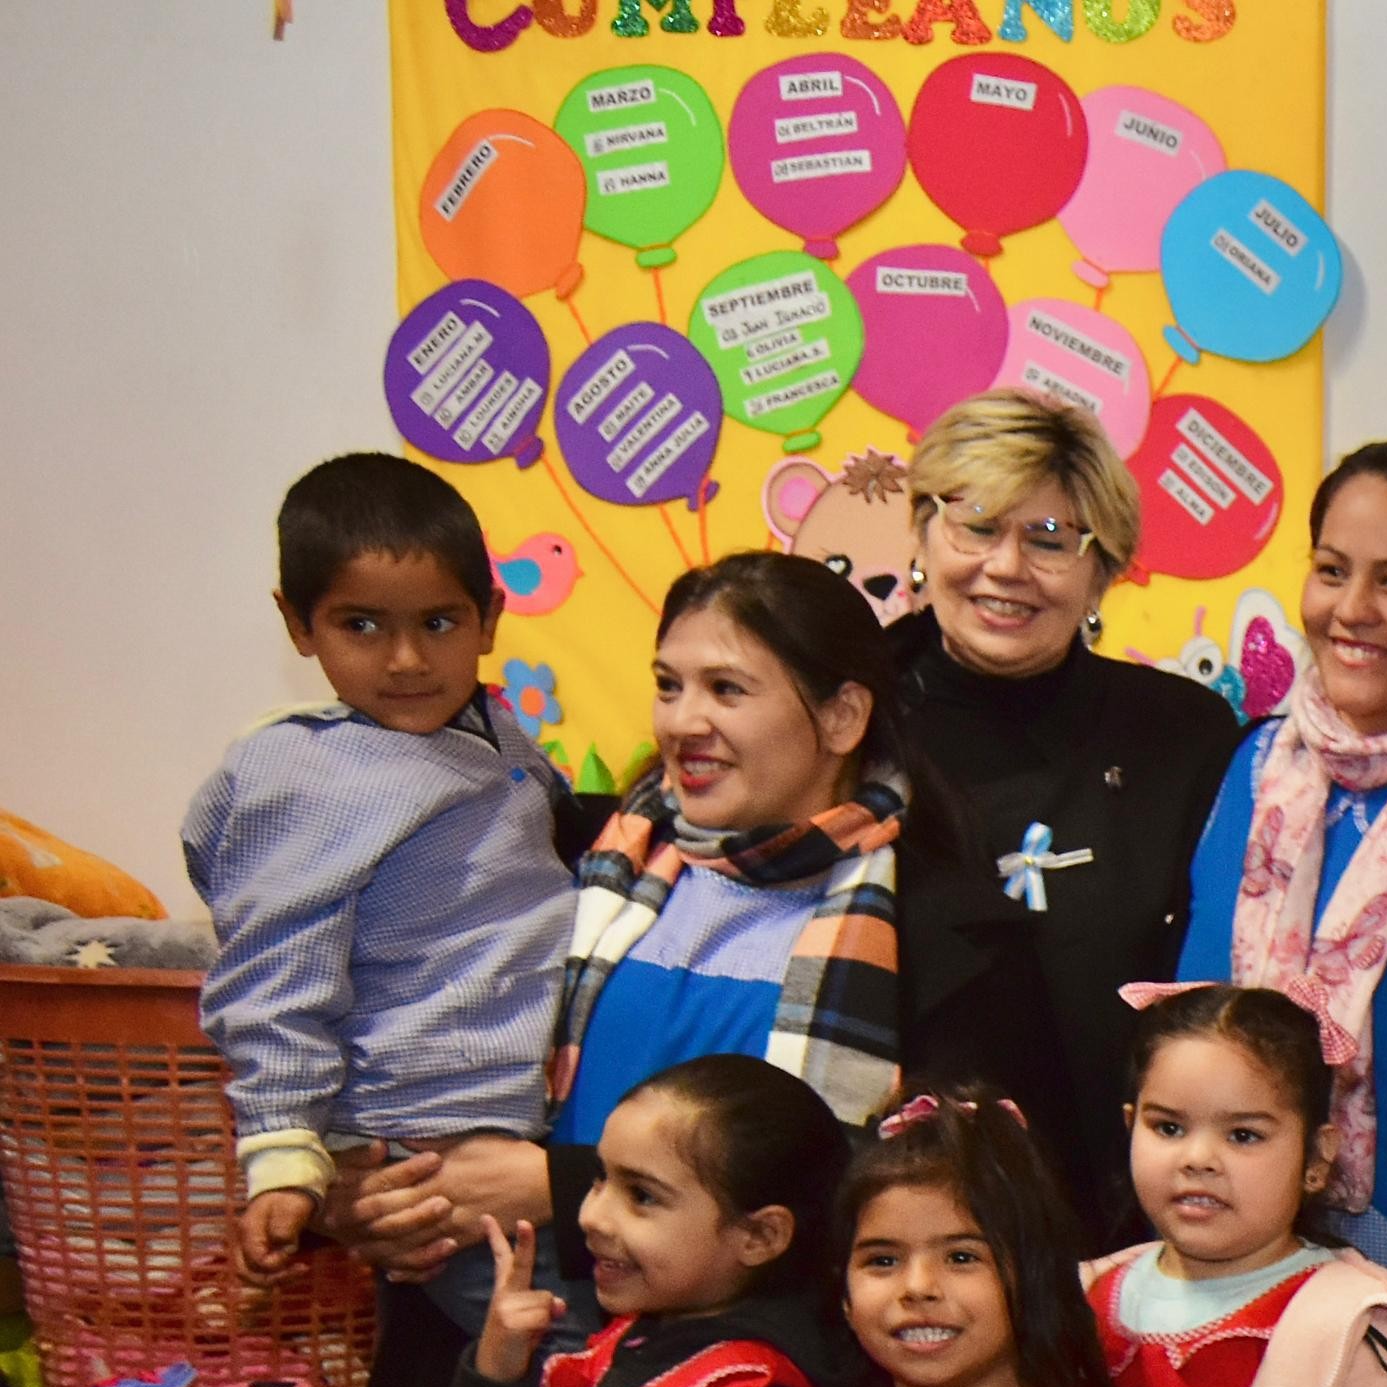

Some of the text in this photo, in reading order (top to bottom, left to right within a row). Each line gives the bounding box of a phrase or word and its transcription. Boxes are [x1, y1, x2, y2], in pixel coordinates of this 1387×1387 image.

[592, 86, 652, 109] MARZO
[787, 79, 840, 94] ABRIL
[975, 80, 1028, 102] MAYO
[1123, 117, 1179, 149] JUNIO
[441, 144, 492, 216] FEBRERO
[1254, 208, 1298, 248] JULIO
[708, 279, 814, 318] SEPTIEMBRE
[881, 273, 964, 291] OCTUBRE
[412, 318, 458, 366] ENERO
[1029, 316, 1124, 376] NOVIEMBRE
[573, 359, 627, 415] AGOSTO
[619, 398, 676, 454] VALENTINA
[1187, 419, 1267, 496] DICIEMBRE
